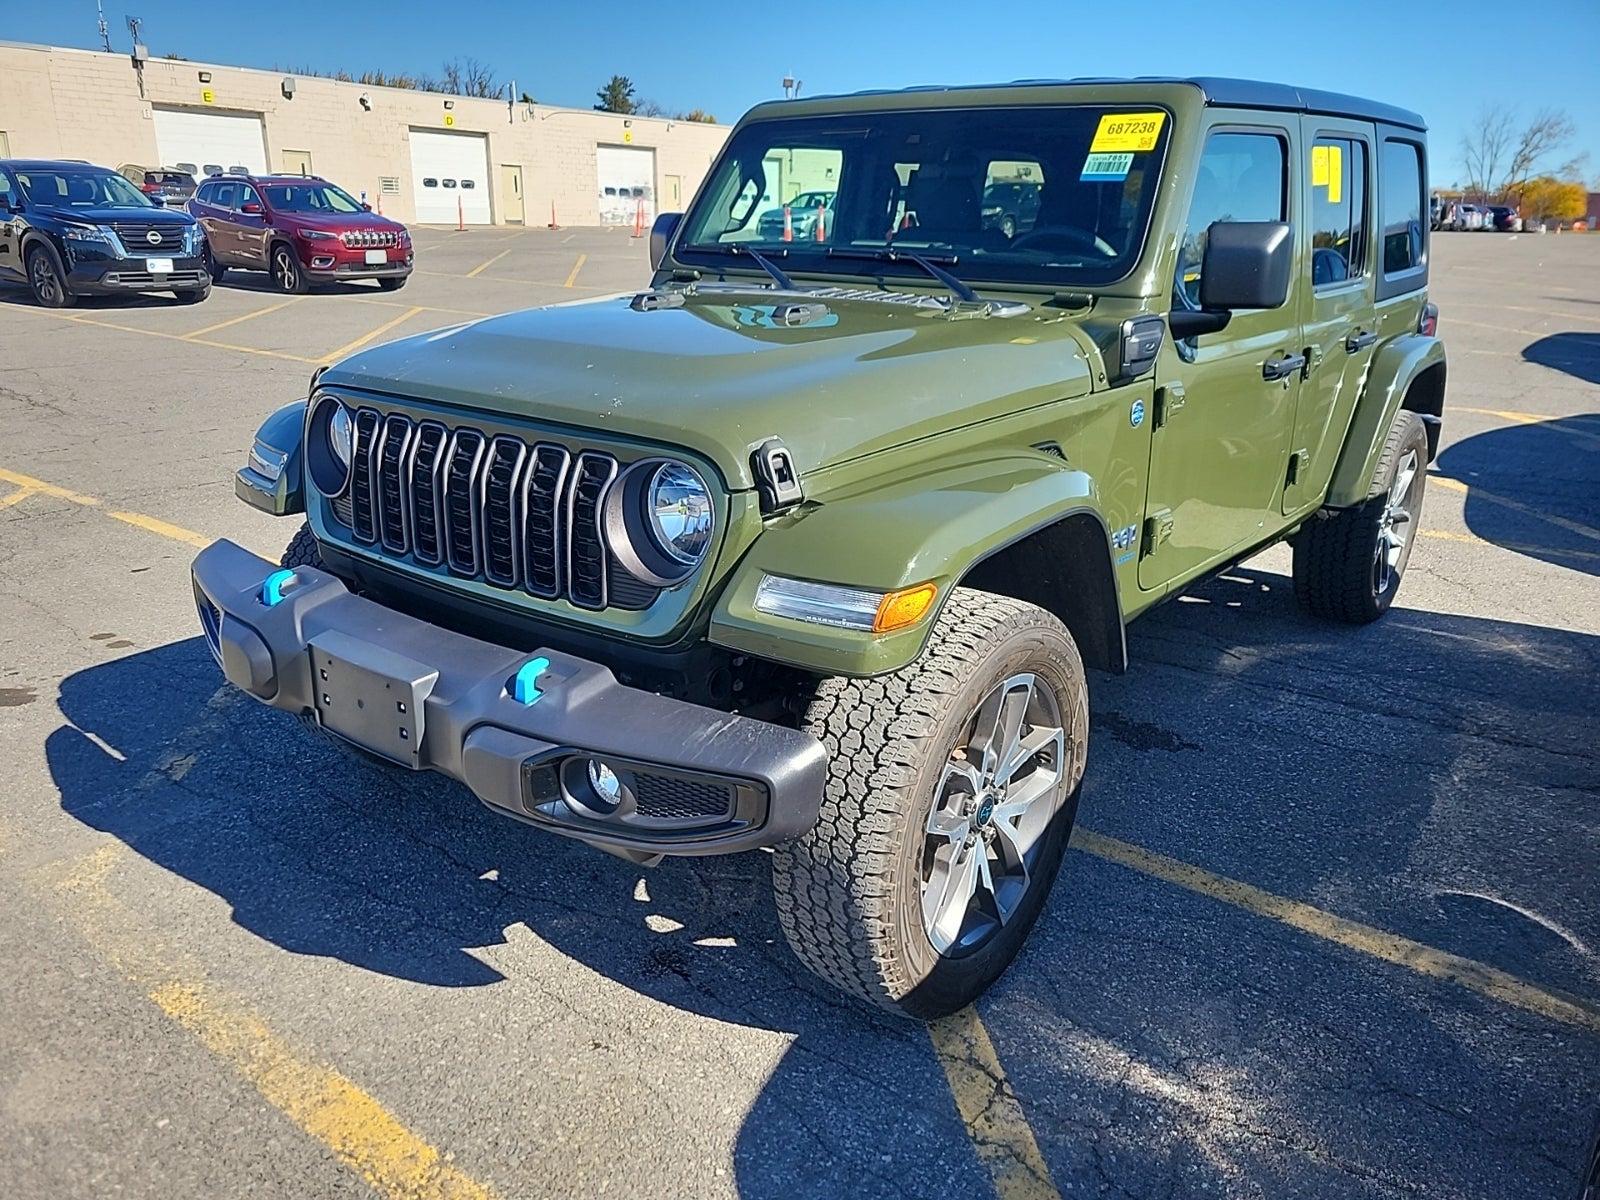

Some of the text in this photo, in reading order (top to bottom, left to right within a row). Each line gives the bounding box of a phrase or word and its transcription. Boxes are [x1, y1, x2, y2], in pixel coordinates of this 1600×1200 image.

[203, 92, 212, 103] E
[446, 116, 453, 126] D
[1107, 121, 1156, 135] 687238
[1112, 524, 1137, 549] eep
